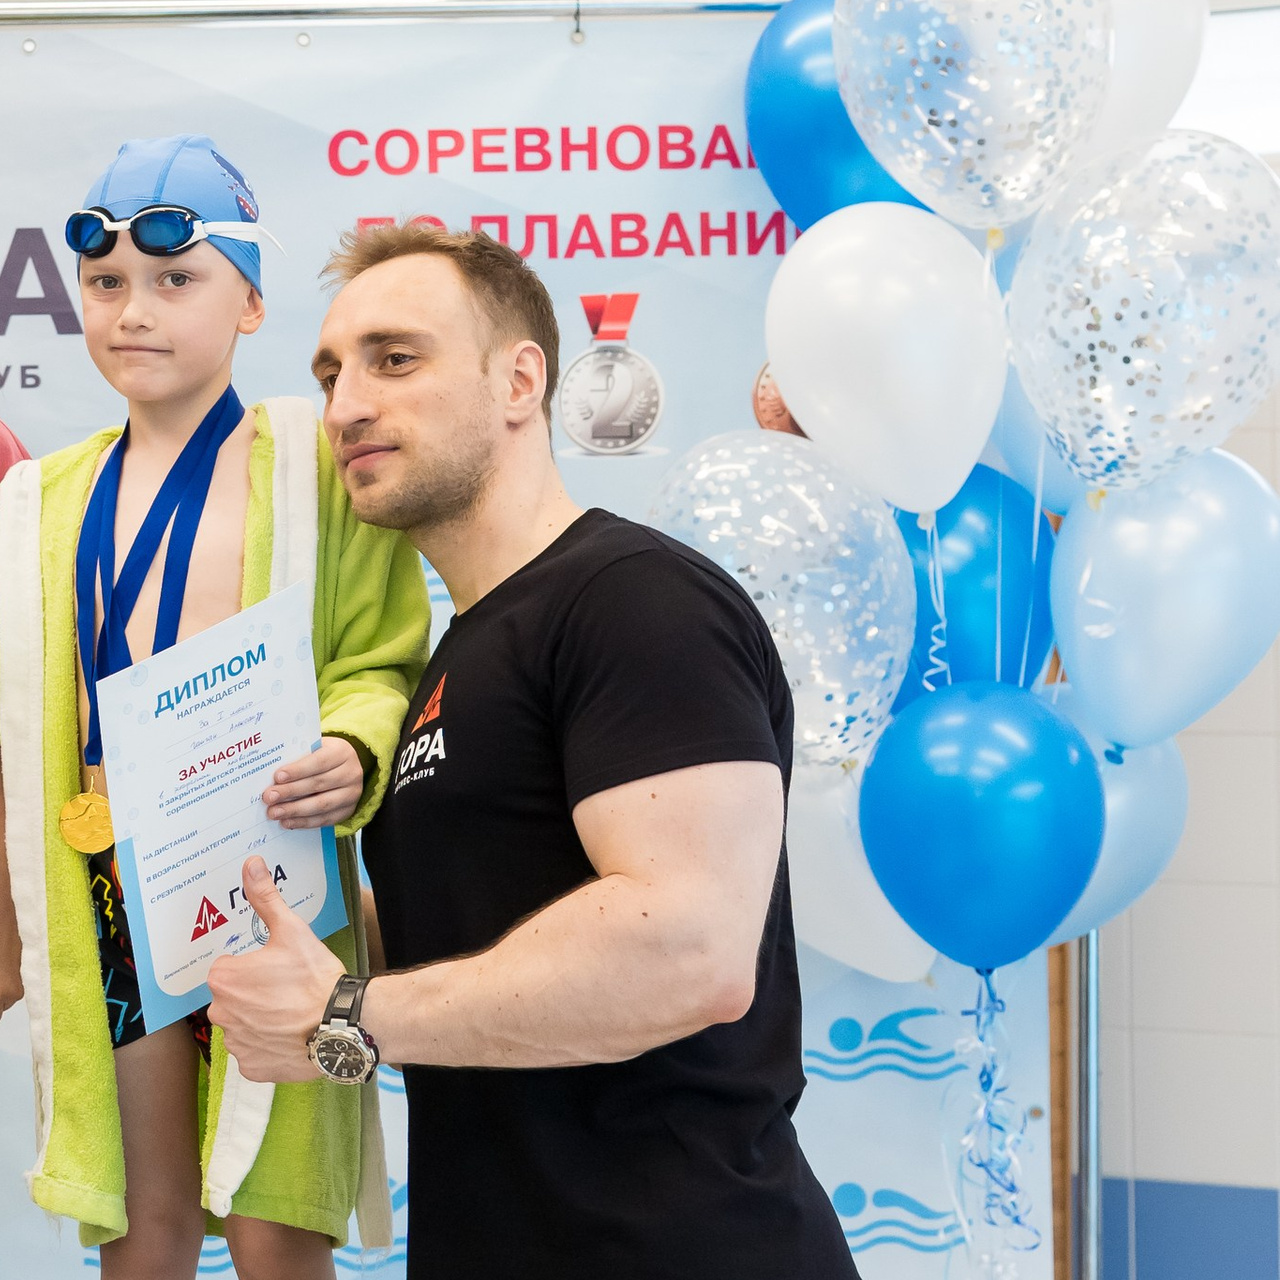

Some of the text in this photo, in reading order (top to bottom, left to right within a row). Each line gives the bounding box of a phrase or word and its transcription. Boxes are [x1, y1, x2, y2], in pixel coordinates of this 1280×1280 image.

[327, 124, 759, 177] СОРЕВНОВА
[471, 211, 803, 260] ПЛАВАНИ
[154, 642, 267, 719] ДИПЛОМ
[176, 678, 251, 721] НАГРАЖДАЕТСЯ
[165, 782, 206, 809] закрытых
[206, 742, 285, 787] детско-юношеских
[178, 765, 198, 782] ЗА
[199, 731, 263, 772] УЧАСТИЕ
[166, 781, 229, 818] соревнованиях
[230, 775, 241, 787] по
[241, 754, 282, 780] плаванию
[142, 829, 199, 862] НА ДИСТАНЦИИ
[146, 876, 152, 884] В
[152, 850, 200, 881] ВОЗРАСТНОЙ
[200, 829, 241, 858] КАТЕГОРИИ
[150, 870, 207, 905] С РЕЗУЛЬТАТОМ
[228, 863, 288, 910] ГА
